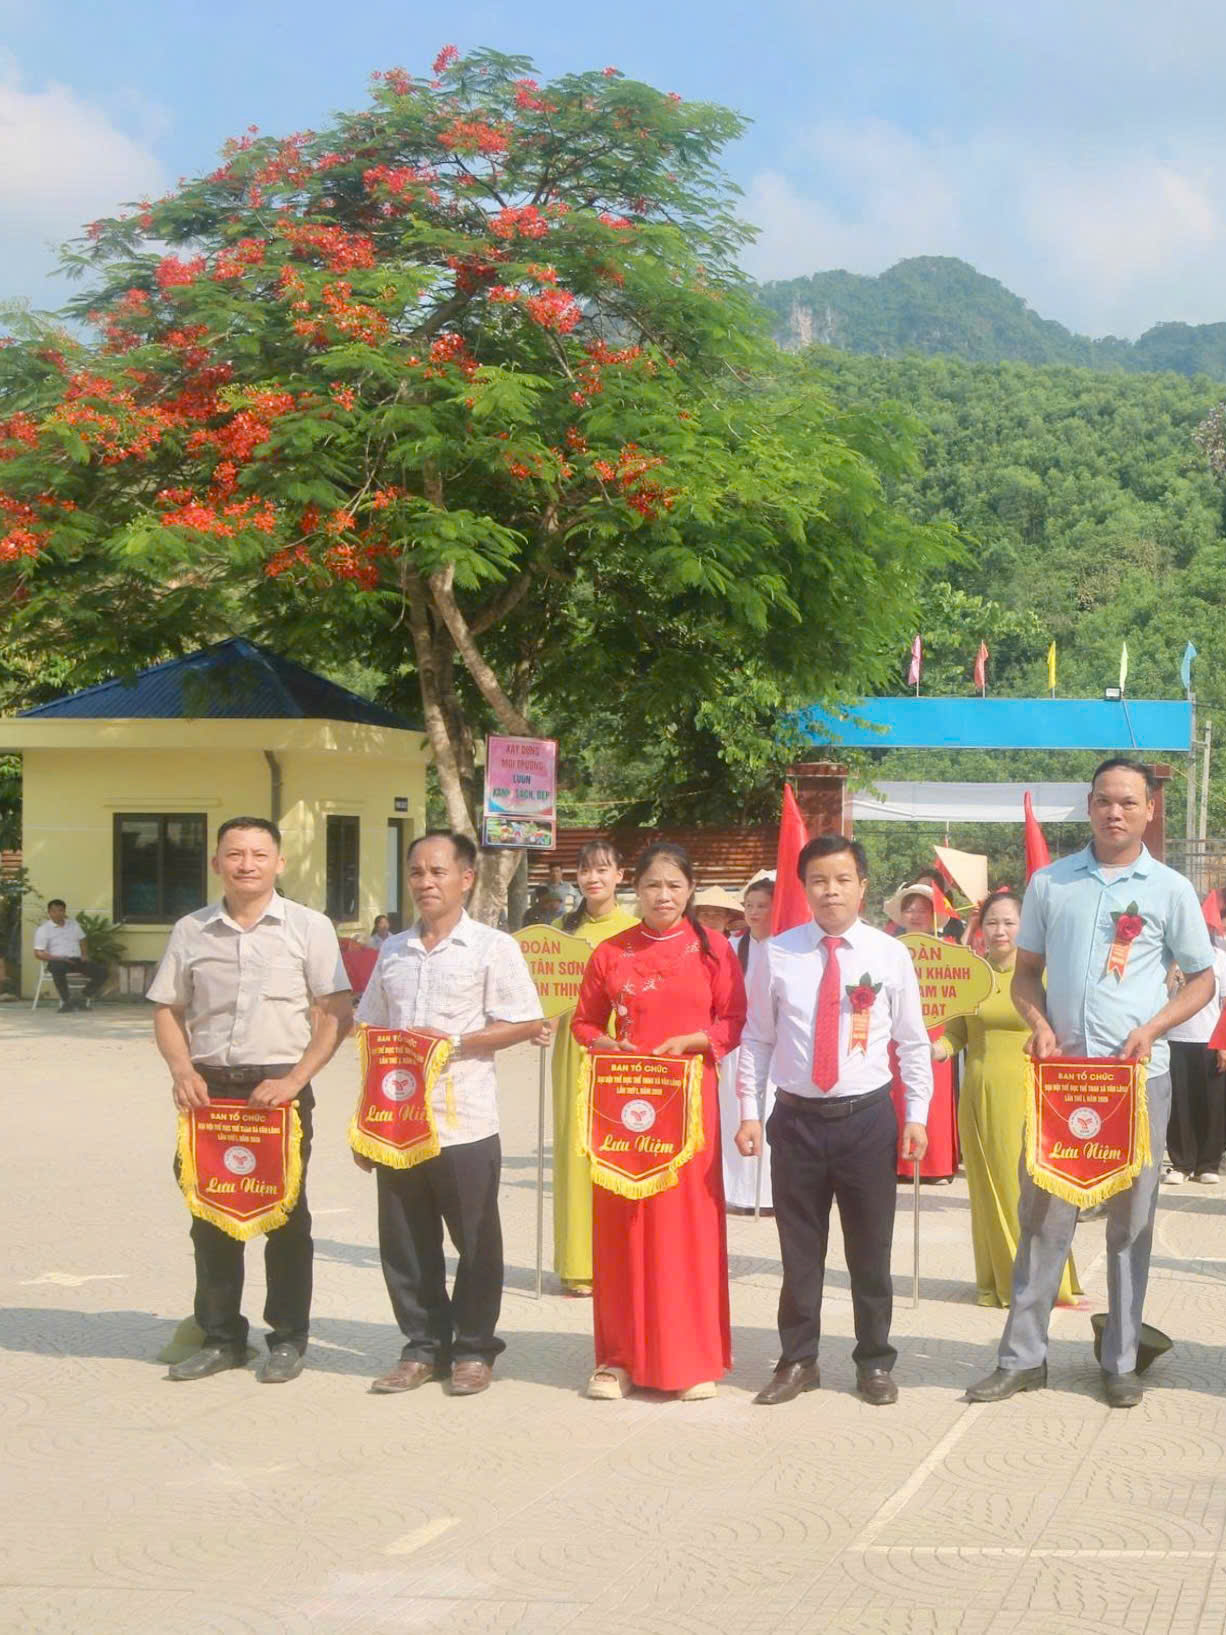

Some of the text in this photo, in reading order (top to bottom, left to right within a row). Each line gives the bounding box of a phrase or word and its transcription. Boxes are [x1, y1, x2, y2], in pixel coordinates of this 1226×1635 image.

[530, 959, 585, 975] TÂN SƠN
[927, 964, 970, 980] KHÁNH
[941, 986, 957, 998] VA
[635, 1135, 674, 1156] Niệm
[1084, 1142, 1121, 1163] Niệm
[241, 1178, 277, 1196] Niệm
